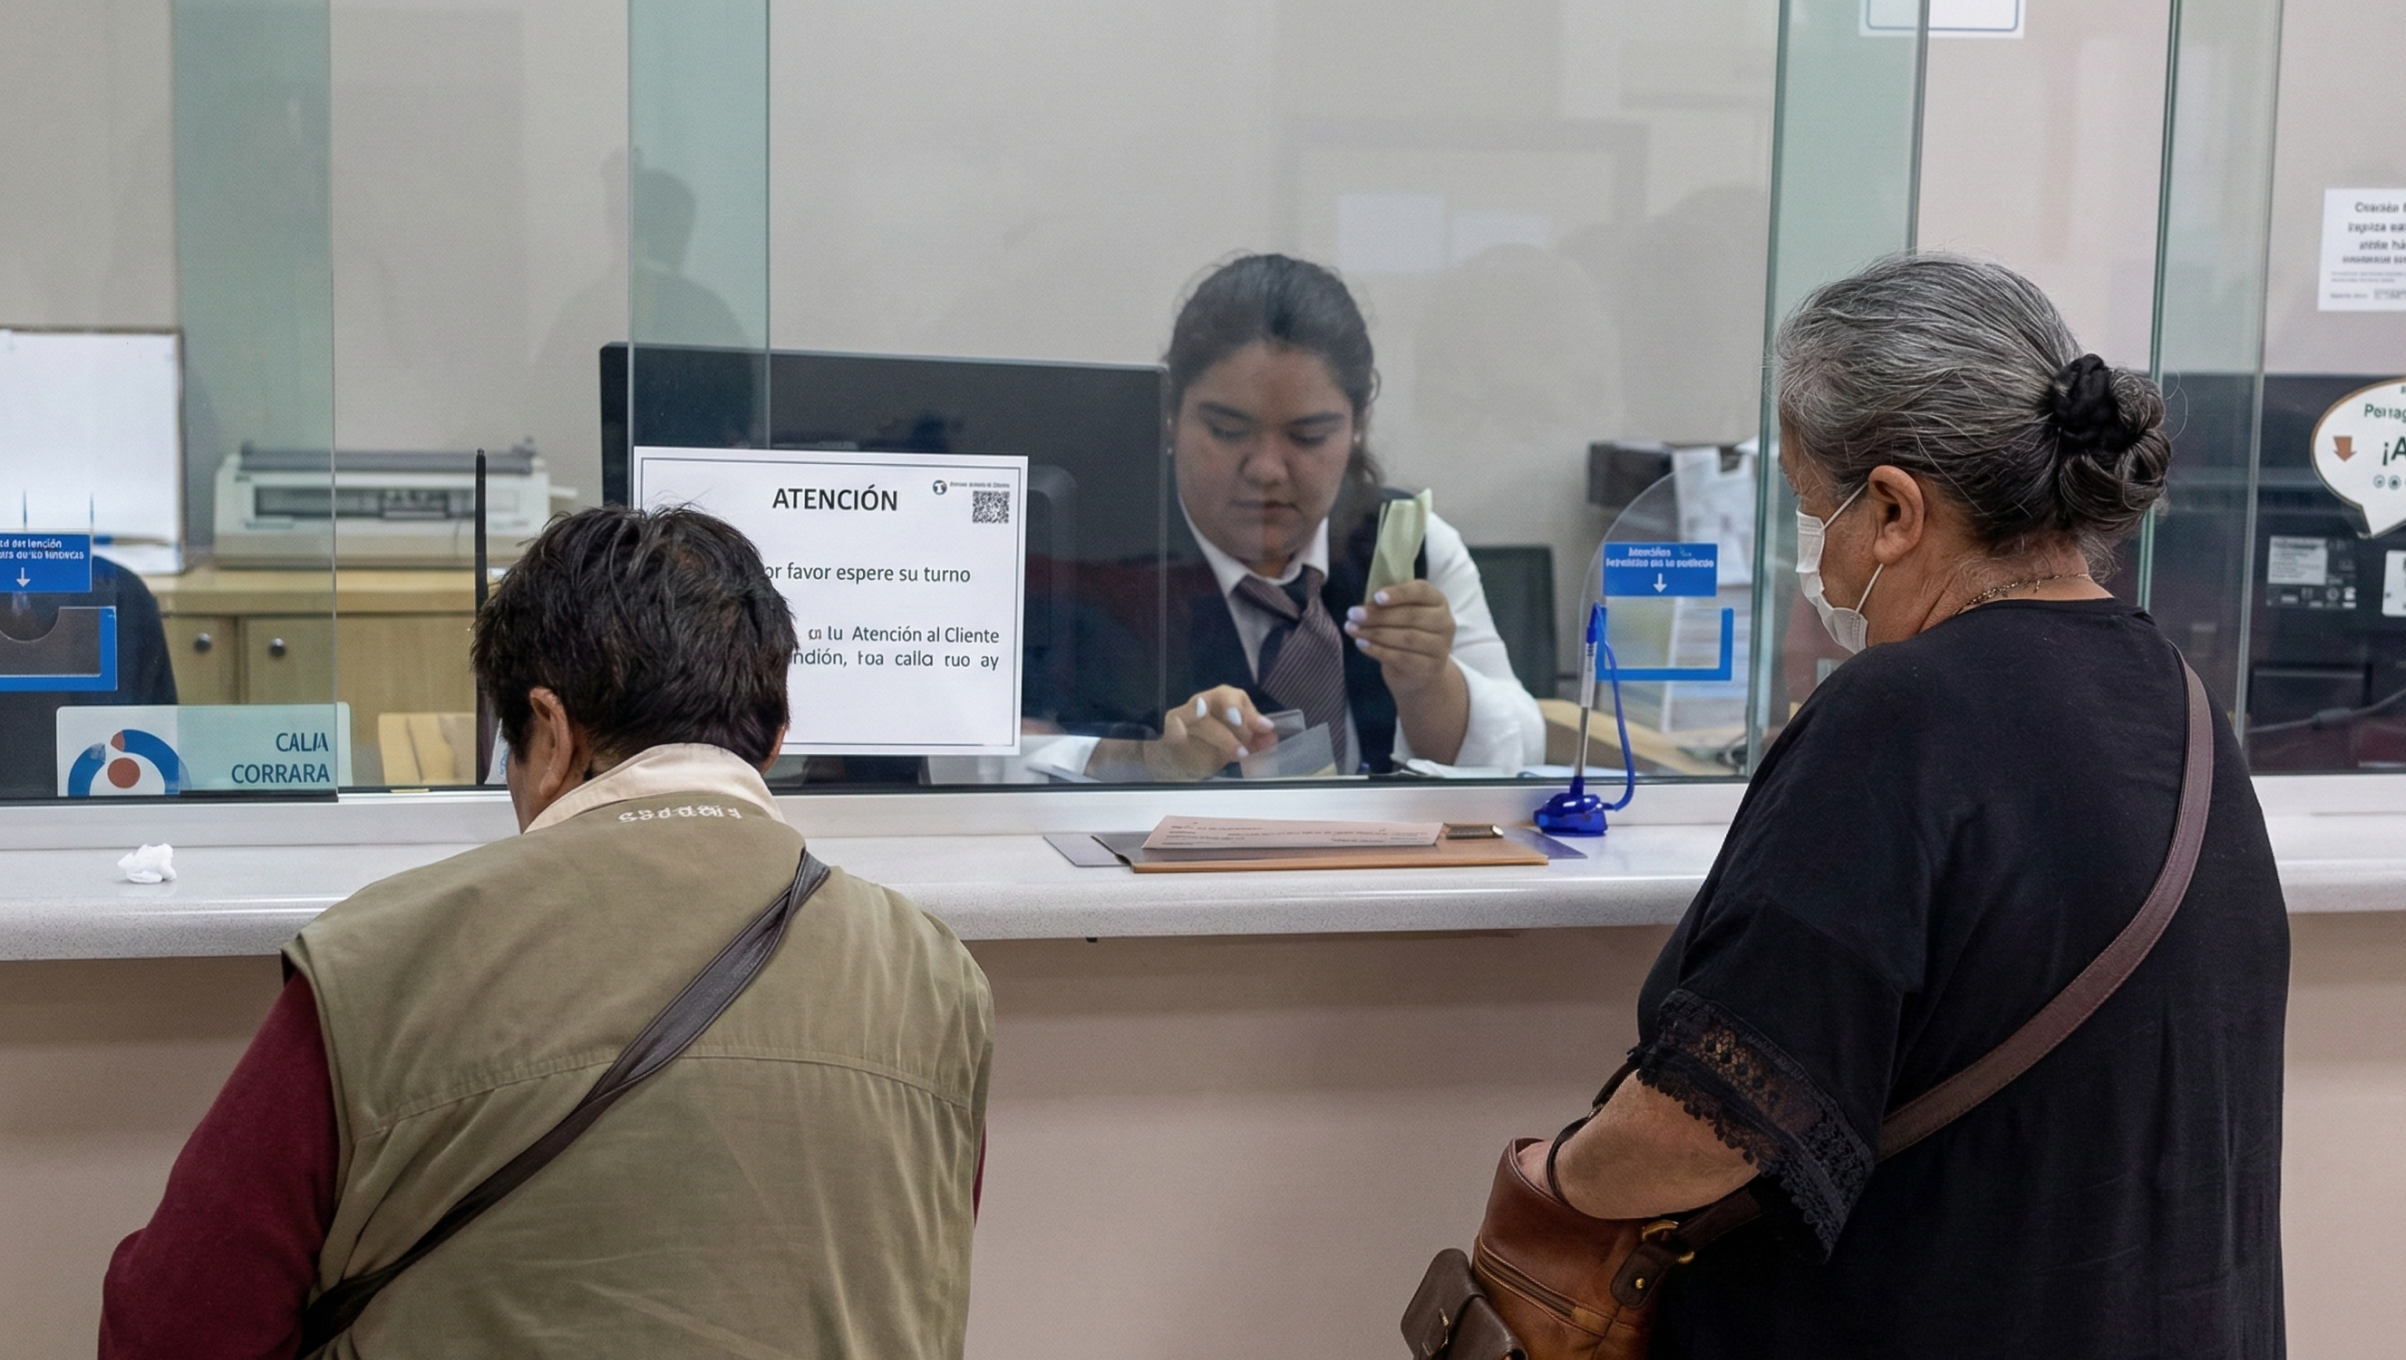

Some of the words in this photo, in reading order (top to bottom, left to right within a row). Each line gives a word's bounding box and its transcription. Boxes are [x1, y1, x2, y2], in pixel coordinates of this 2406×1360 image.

[772, 484, 898, 511] ATENCIÓN
[764, 566, 782, 580] or
[787, 562, 831, 580] favor
[836, 567, 893, 585] espere
[899, 567, 918, 582] su
[924, 565, 971, 583] turno
[852, 625, 922, 642] Atención
[927, 626, 940, 643] al
[945, 626, 1000, 644] Cliente
[793, 648, 847, 668] ndión,
[981, 655, 999, 671] ay
[231, 763, 330, 784] CORRARA
